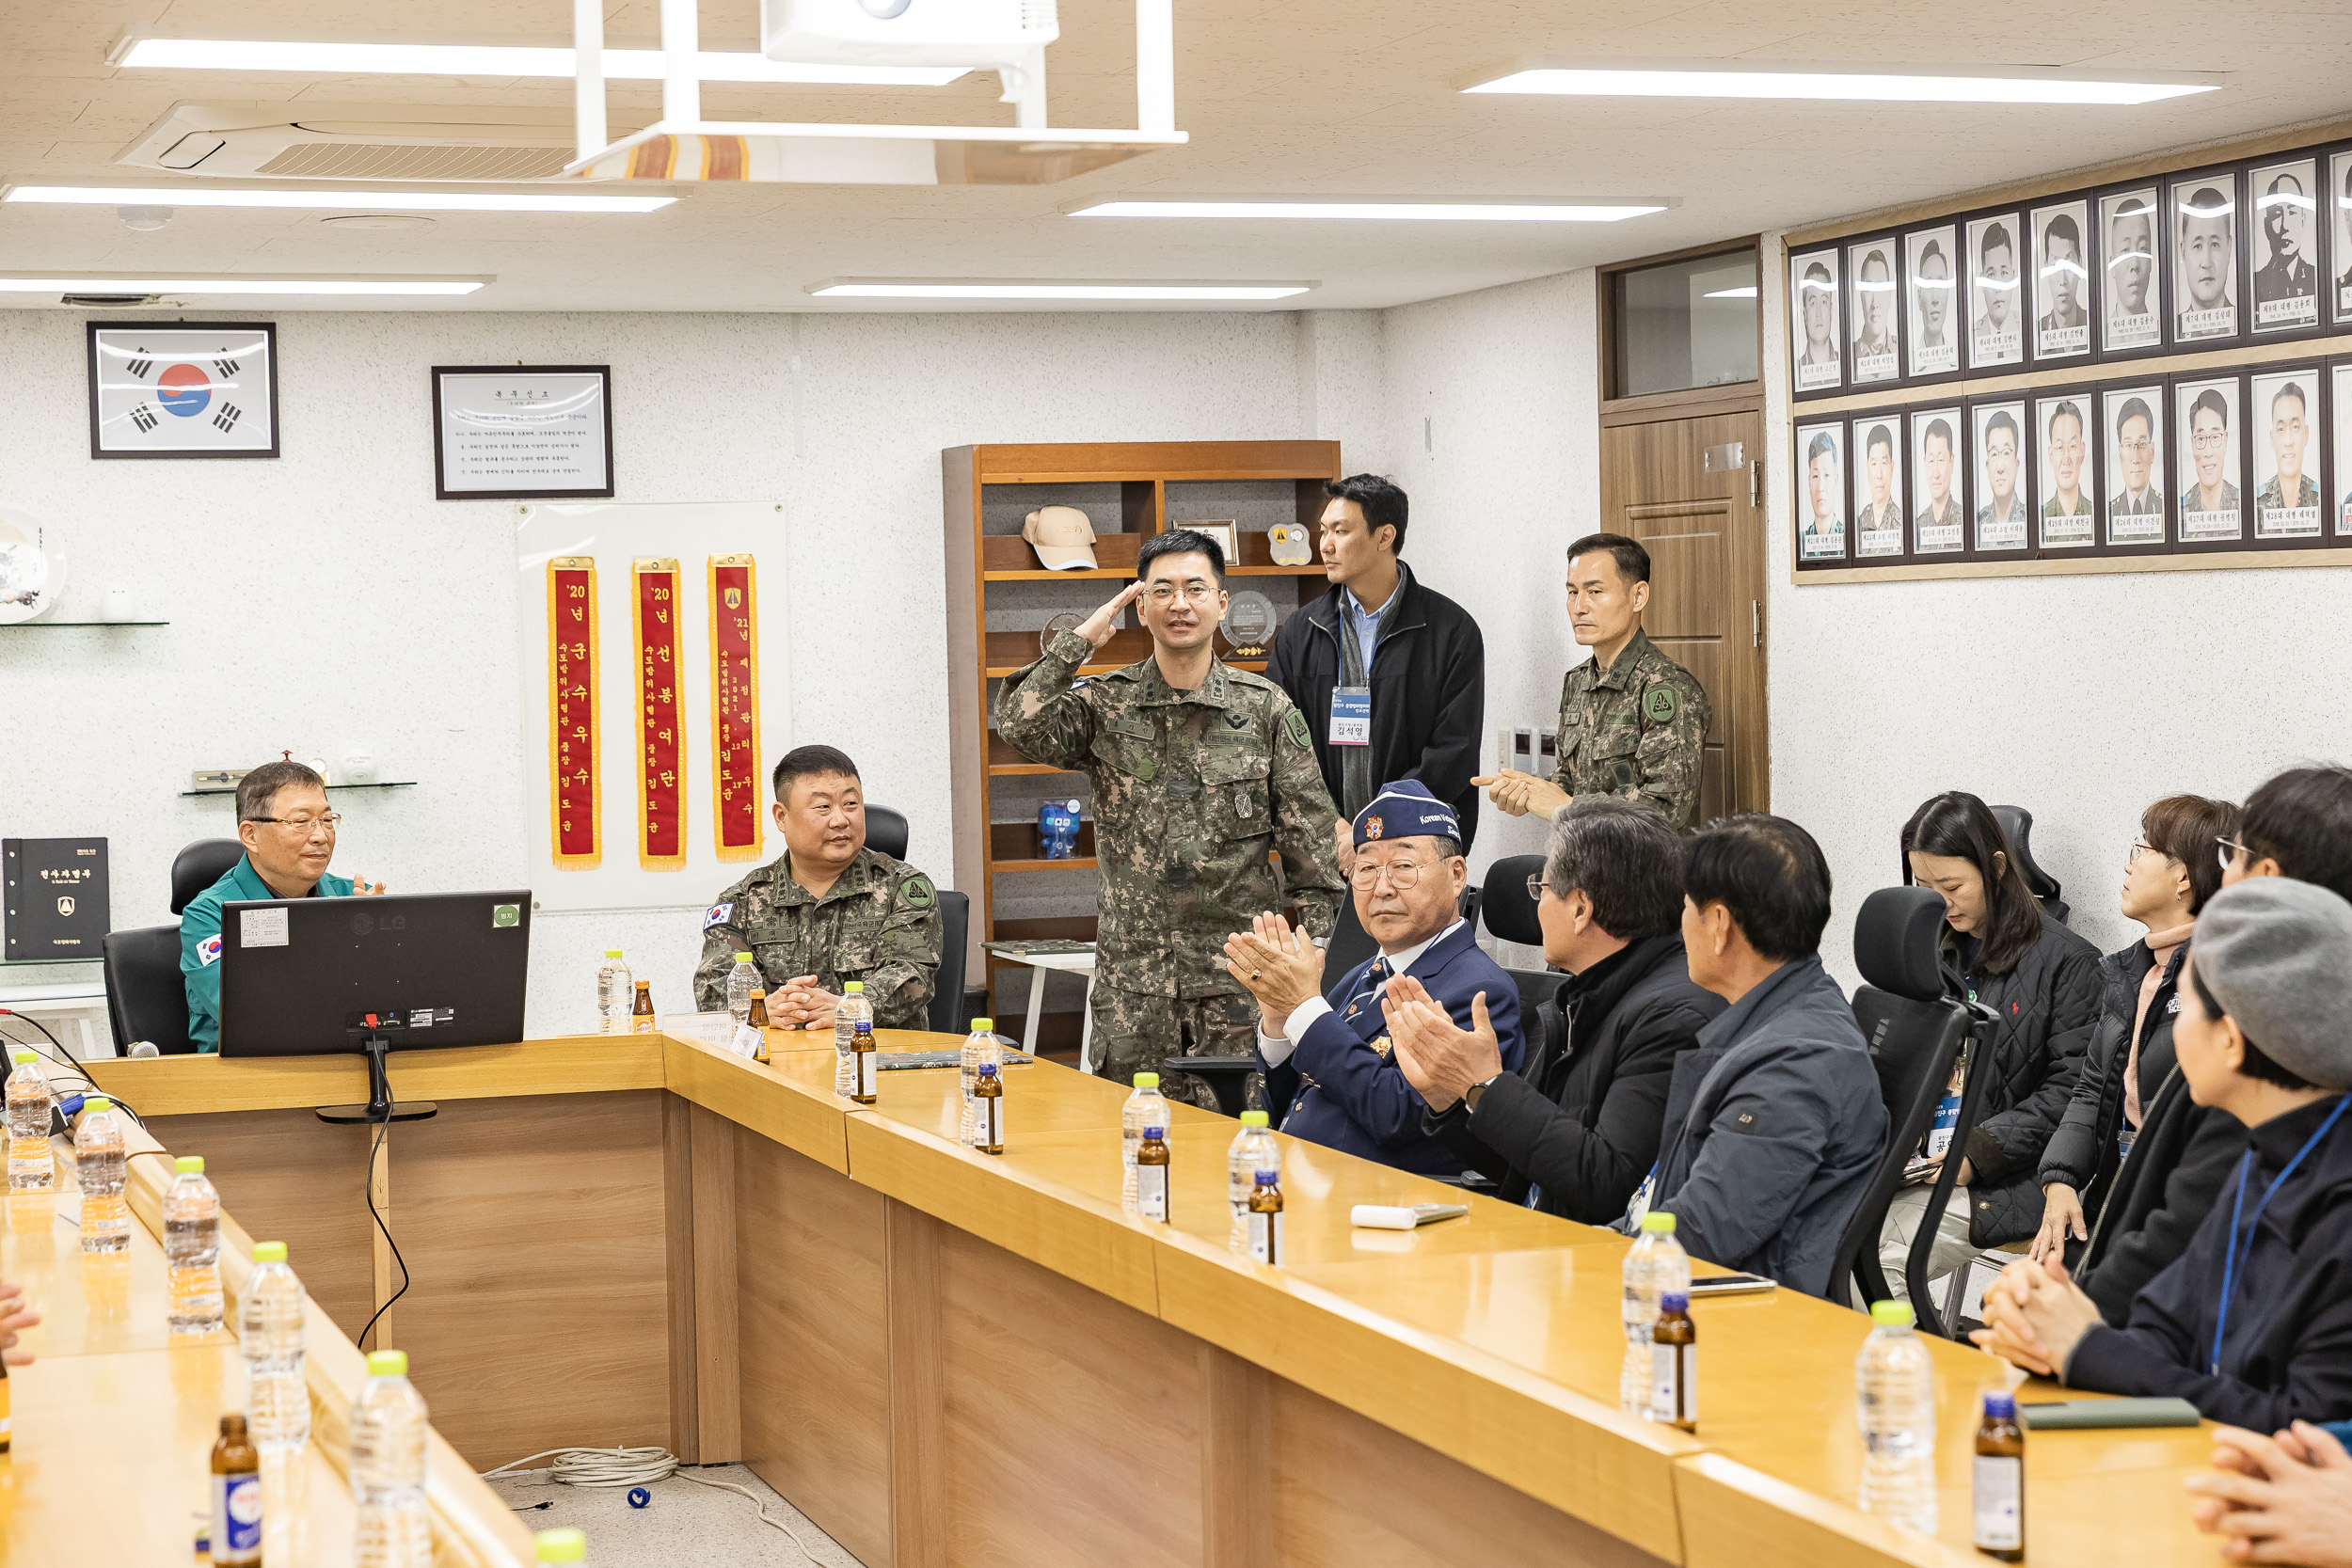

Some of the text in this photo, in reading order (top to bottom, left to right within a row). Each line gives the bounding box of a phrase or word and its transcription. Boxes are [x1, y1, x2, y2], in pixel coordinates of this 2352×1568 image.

[559, 642, 570, 726] 수도방위사령관
[644, 645, 656, 728] 수도방위사령관
[570, 642, 589, 786] 군수우수
[657, 644, 675, 788] 선봉여단
[721, 749, 734, 801] 김도균
[561, 776, 572, 832] 김도균
[647, 778, 659, 833] 김도균
[1419, 815, 1441, 825] Korean
[380, 915, 406, 929] LG
